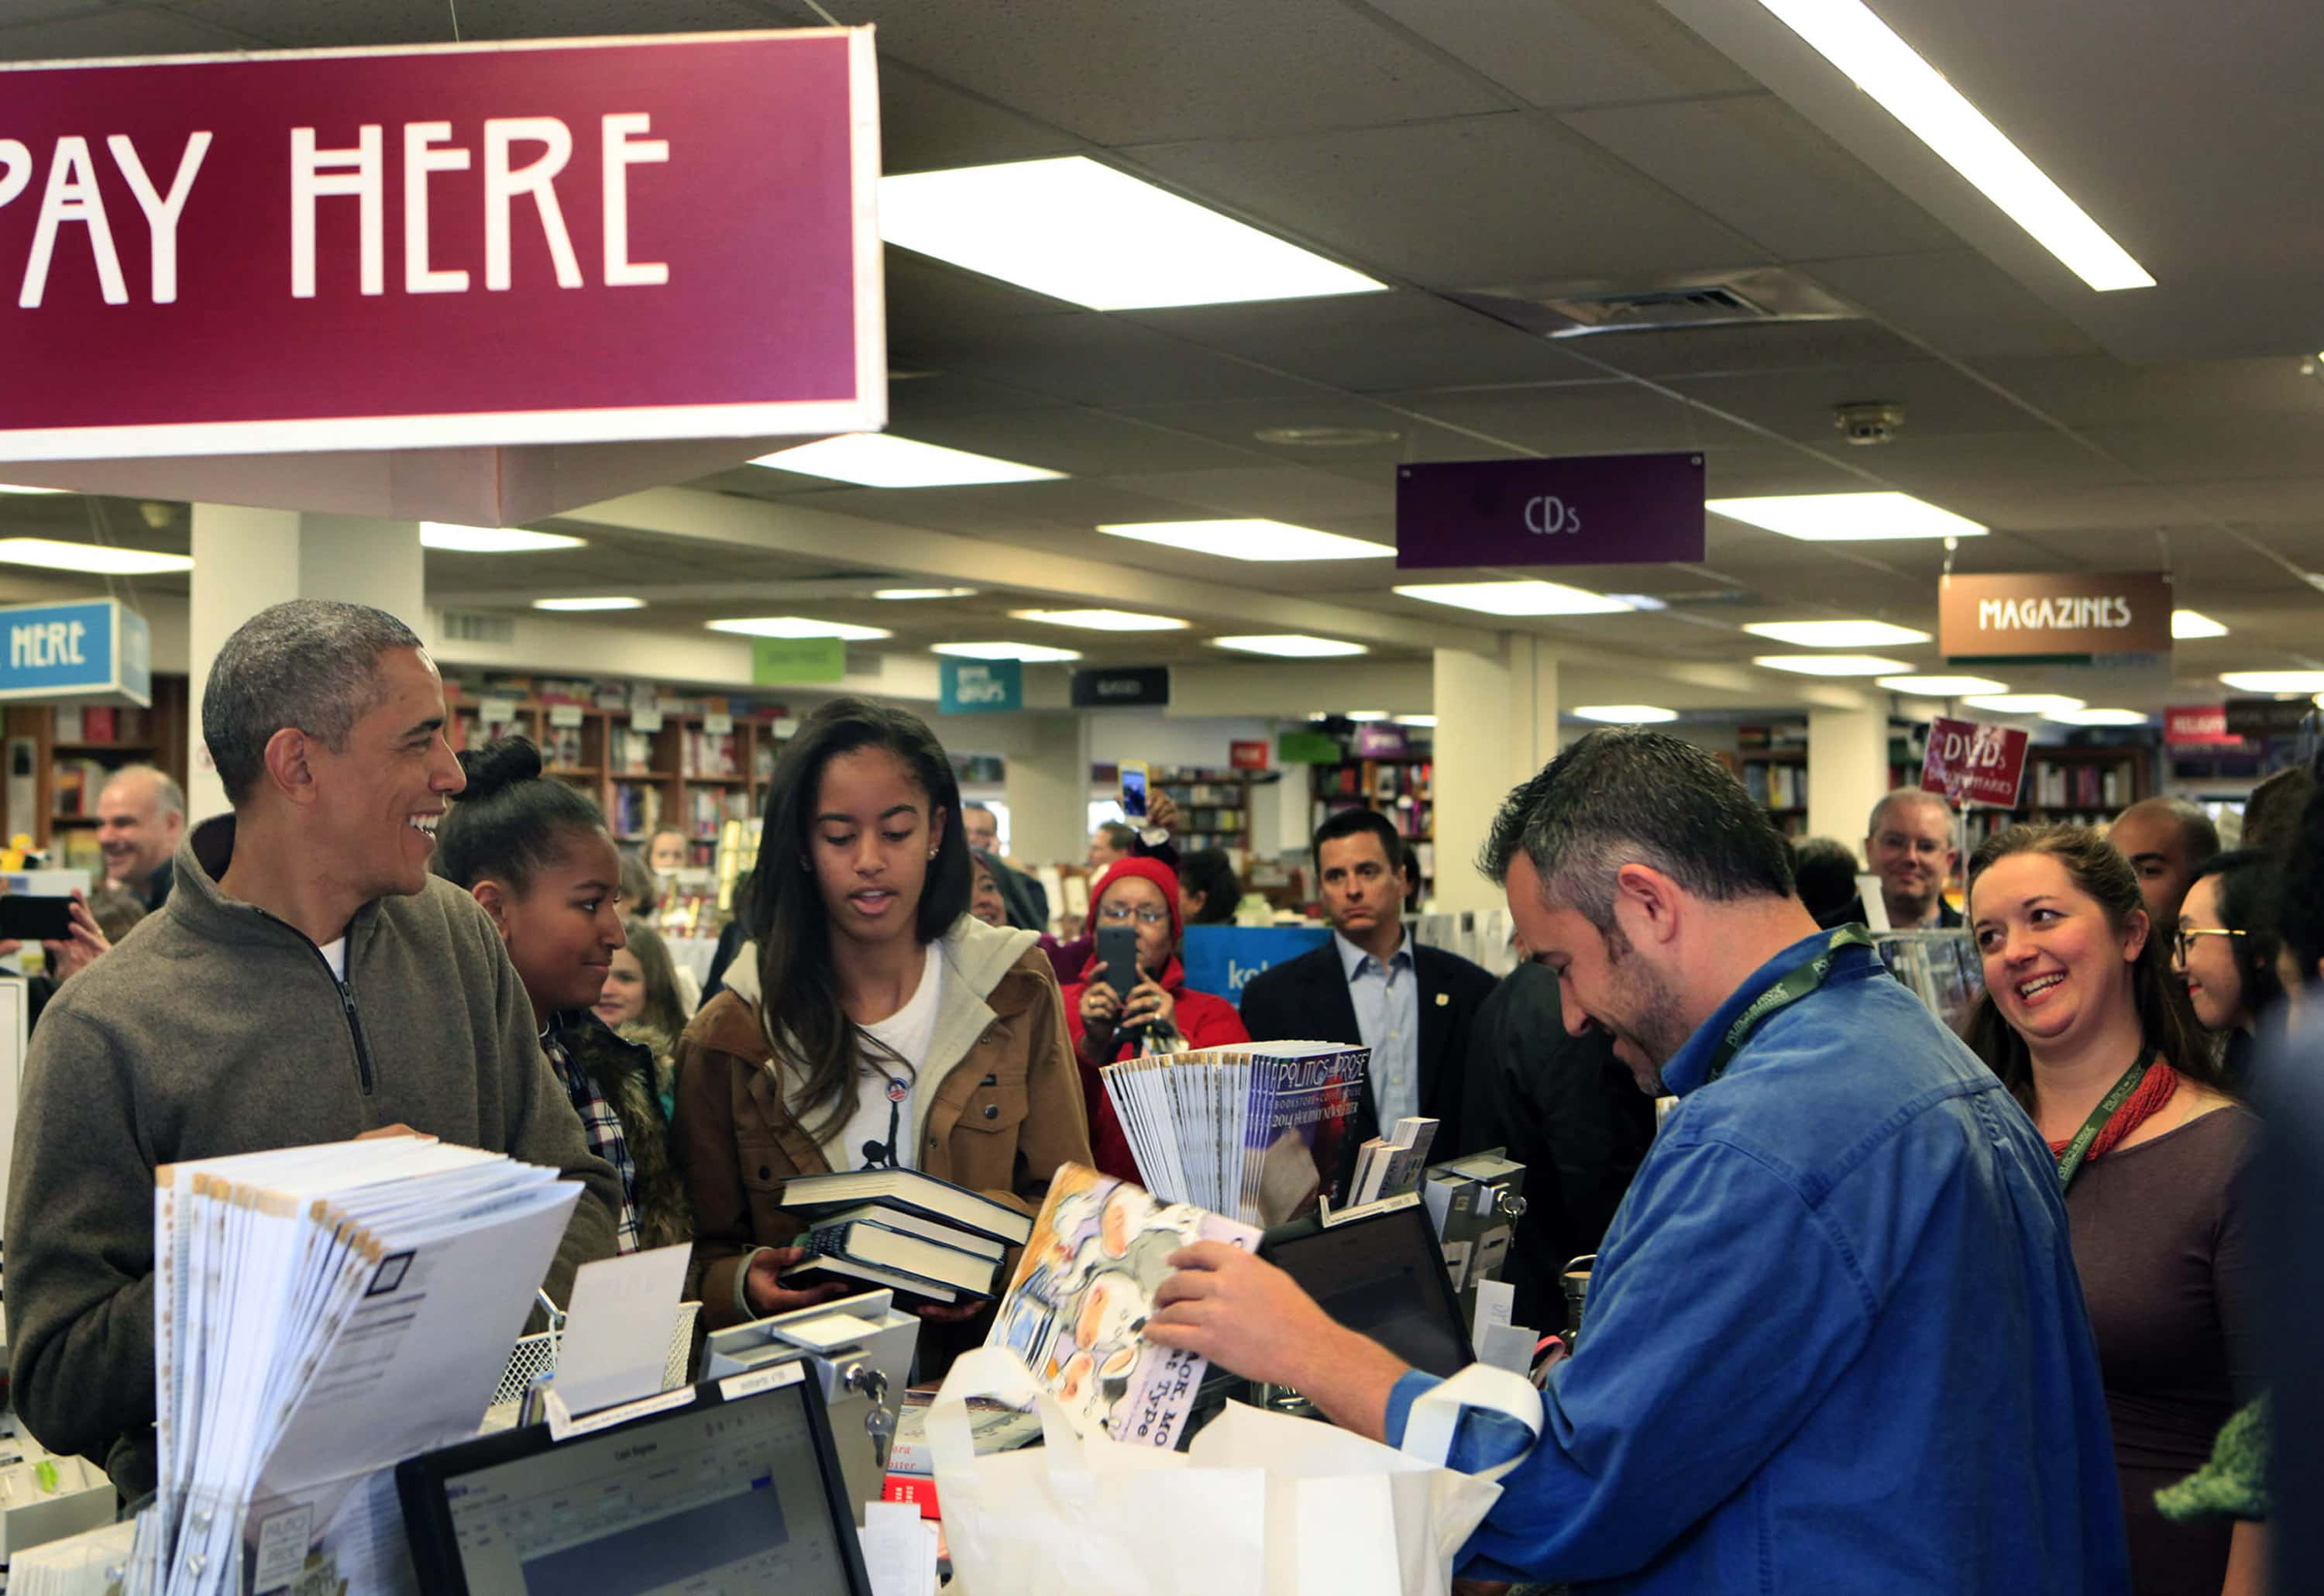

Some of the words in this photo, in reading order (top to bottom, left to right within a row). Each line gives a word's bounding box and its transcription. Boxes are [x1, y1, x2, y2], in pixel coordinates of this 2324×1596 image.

[290, 112, 669, 299] HERE
[1525, 496, 1580, 534] CDs
[1978, 597, 2131, 631] MAGAZINES
[11, 621, 86, 669] HERE
[1277, 1058, 1330, 1090] POLITICS
[1271, 1114, 1293, 1129] 2014
[1137, 1380, 1171, 1437] Type
